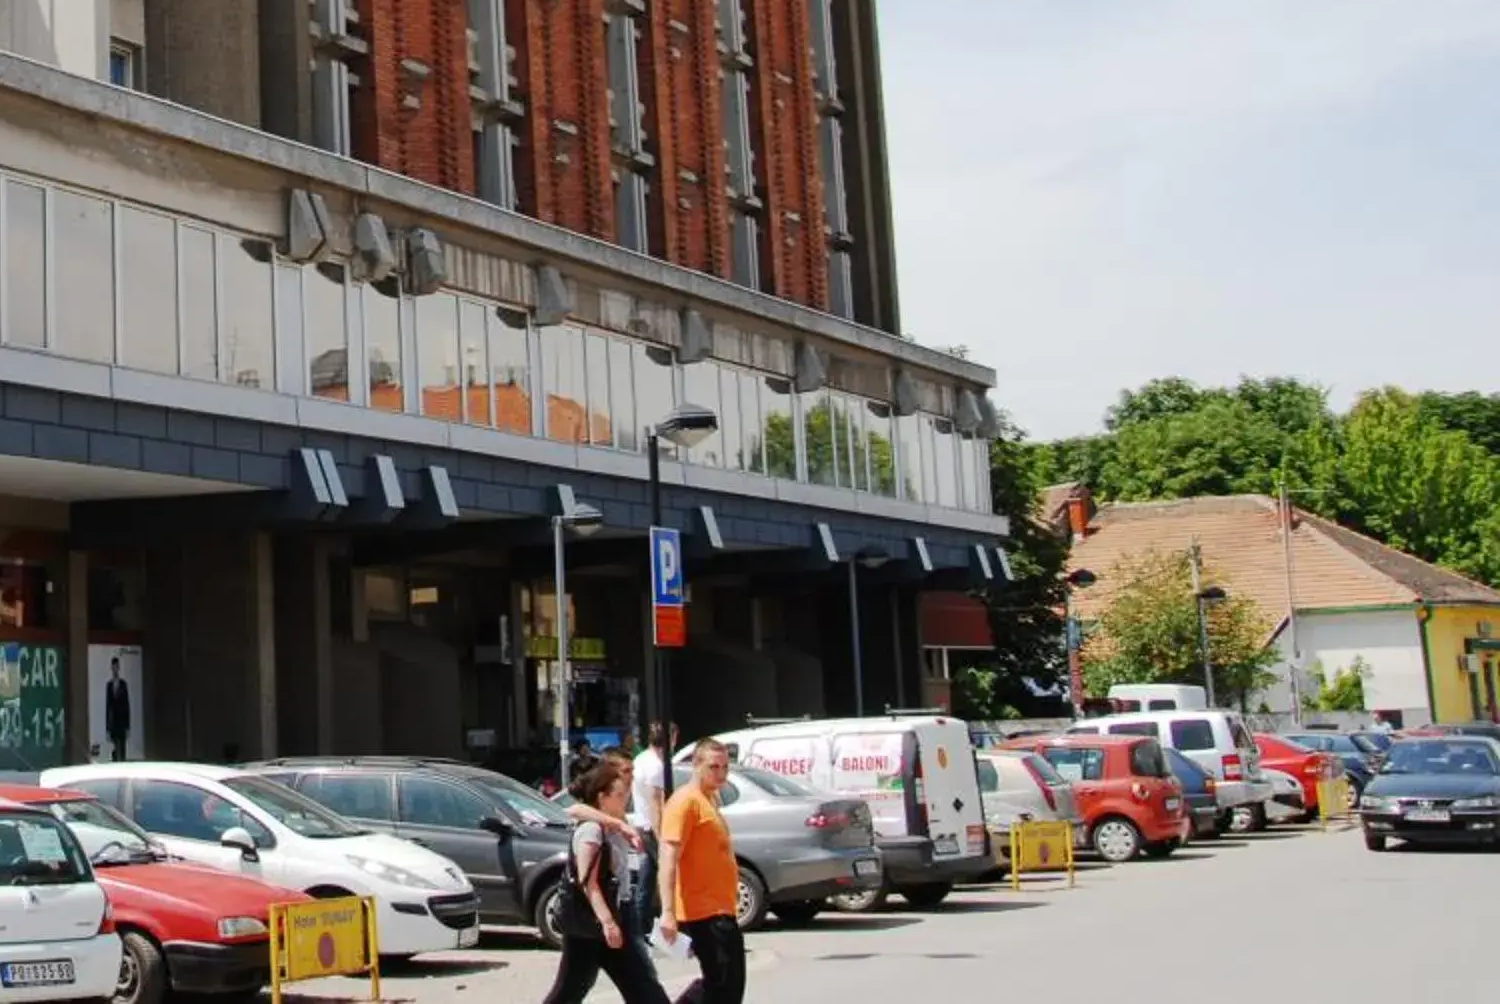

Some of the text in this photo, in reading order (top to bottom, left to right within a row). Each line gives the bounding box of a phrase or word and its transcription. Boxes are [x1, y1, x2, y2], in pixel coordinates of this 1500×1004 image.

[659, 539, 676, 595] P
[17, 646, 58, 688] CAR
[842, 756, 889, 772] BALONI
